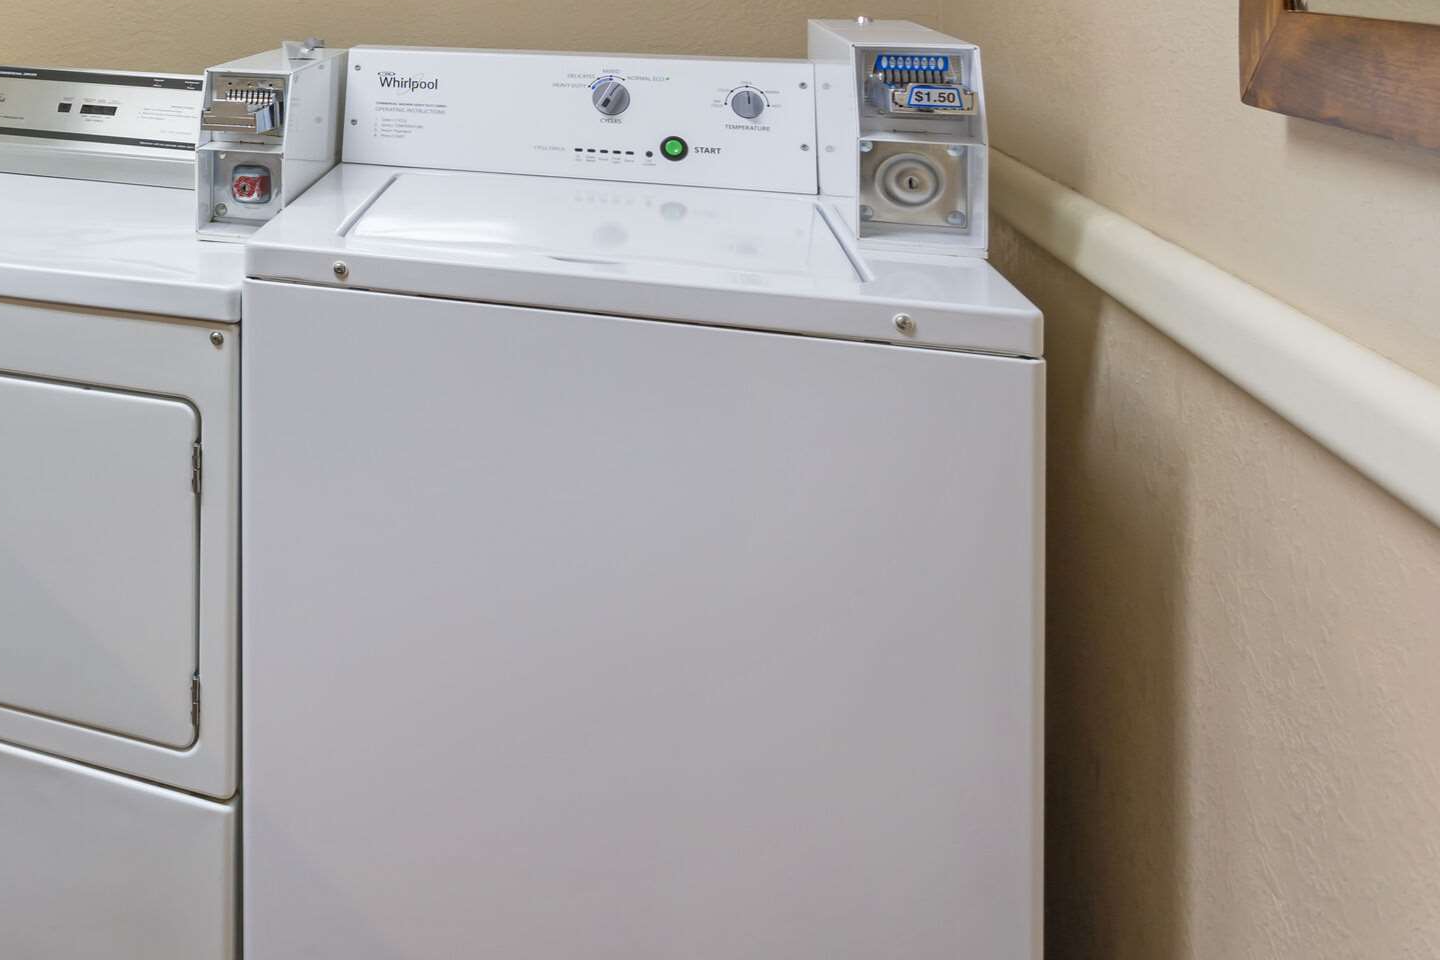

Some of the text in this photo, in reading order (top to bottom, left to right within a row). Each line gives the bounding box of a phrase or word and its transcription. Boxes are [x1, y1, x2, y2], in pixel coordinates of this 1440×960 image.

[379, 76, 438, 93] Whirlpool
[914, 90, 956, 103] $1.50
[725, 123, 771, 132] TEMPERATURE
[693, 145, 722, 155] START
